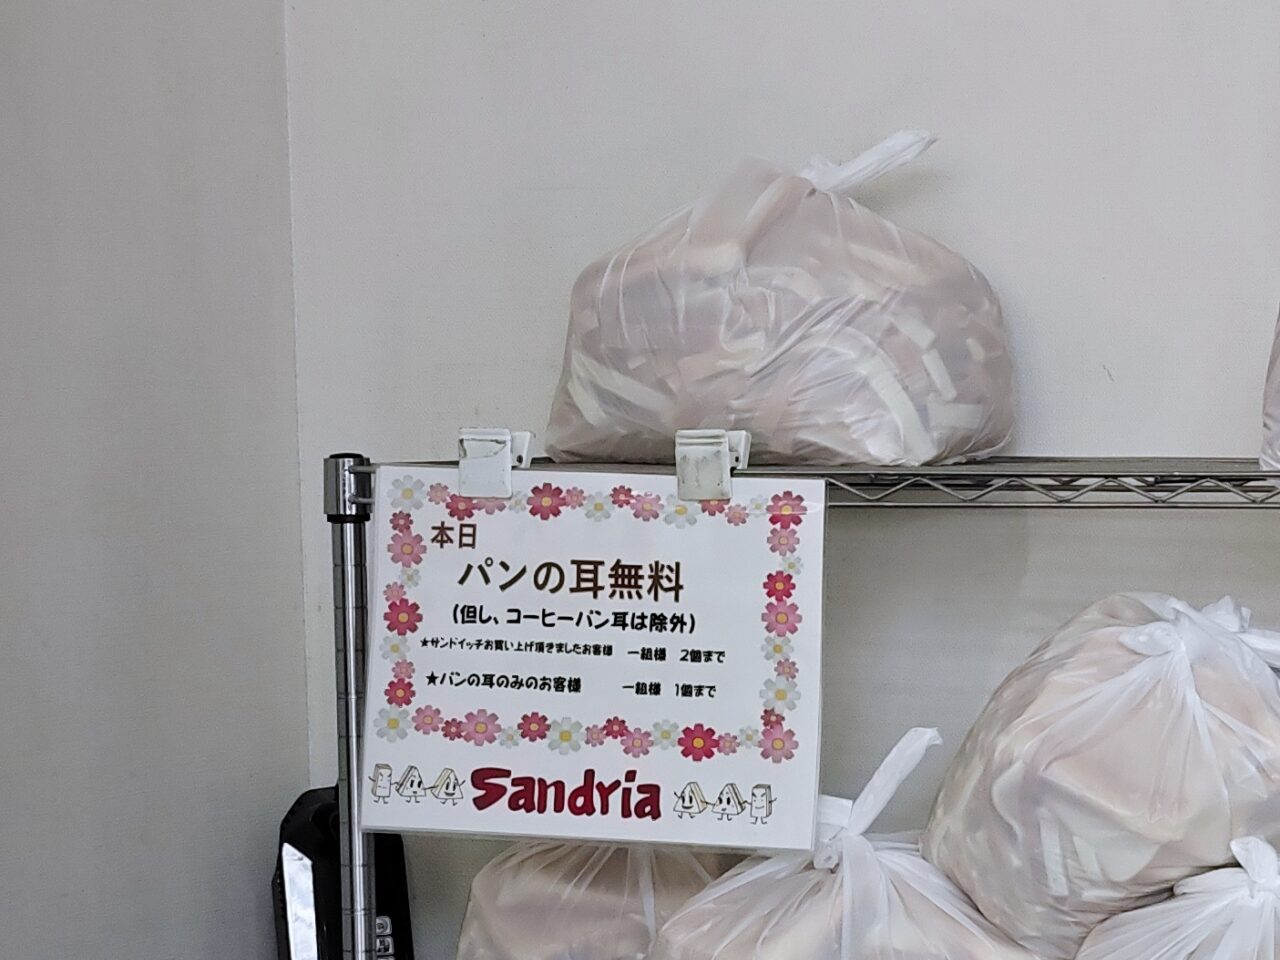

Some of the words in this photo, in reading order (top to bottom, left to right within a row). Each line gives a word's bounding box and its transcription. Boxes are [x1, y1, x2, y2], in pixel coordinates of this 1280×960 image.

[430, 521, 477, 549] 本日
[458, 556, 684, 603] パンの耳無料
[679, 648, 726, 664] 2個まで
[470, 766, 662, 820] Sandria
